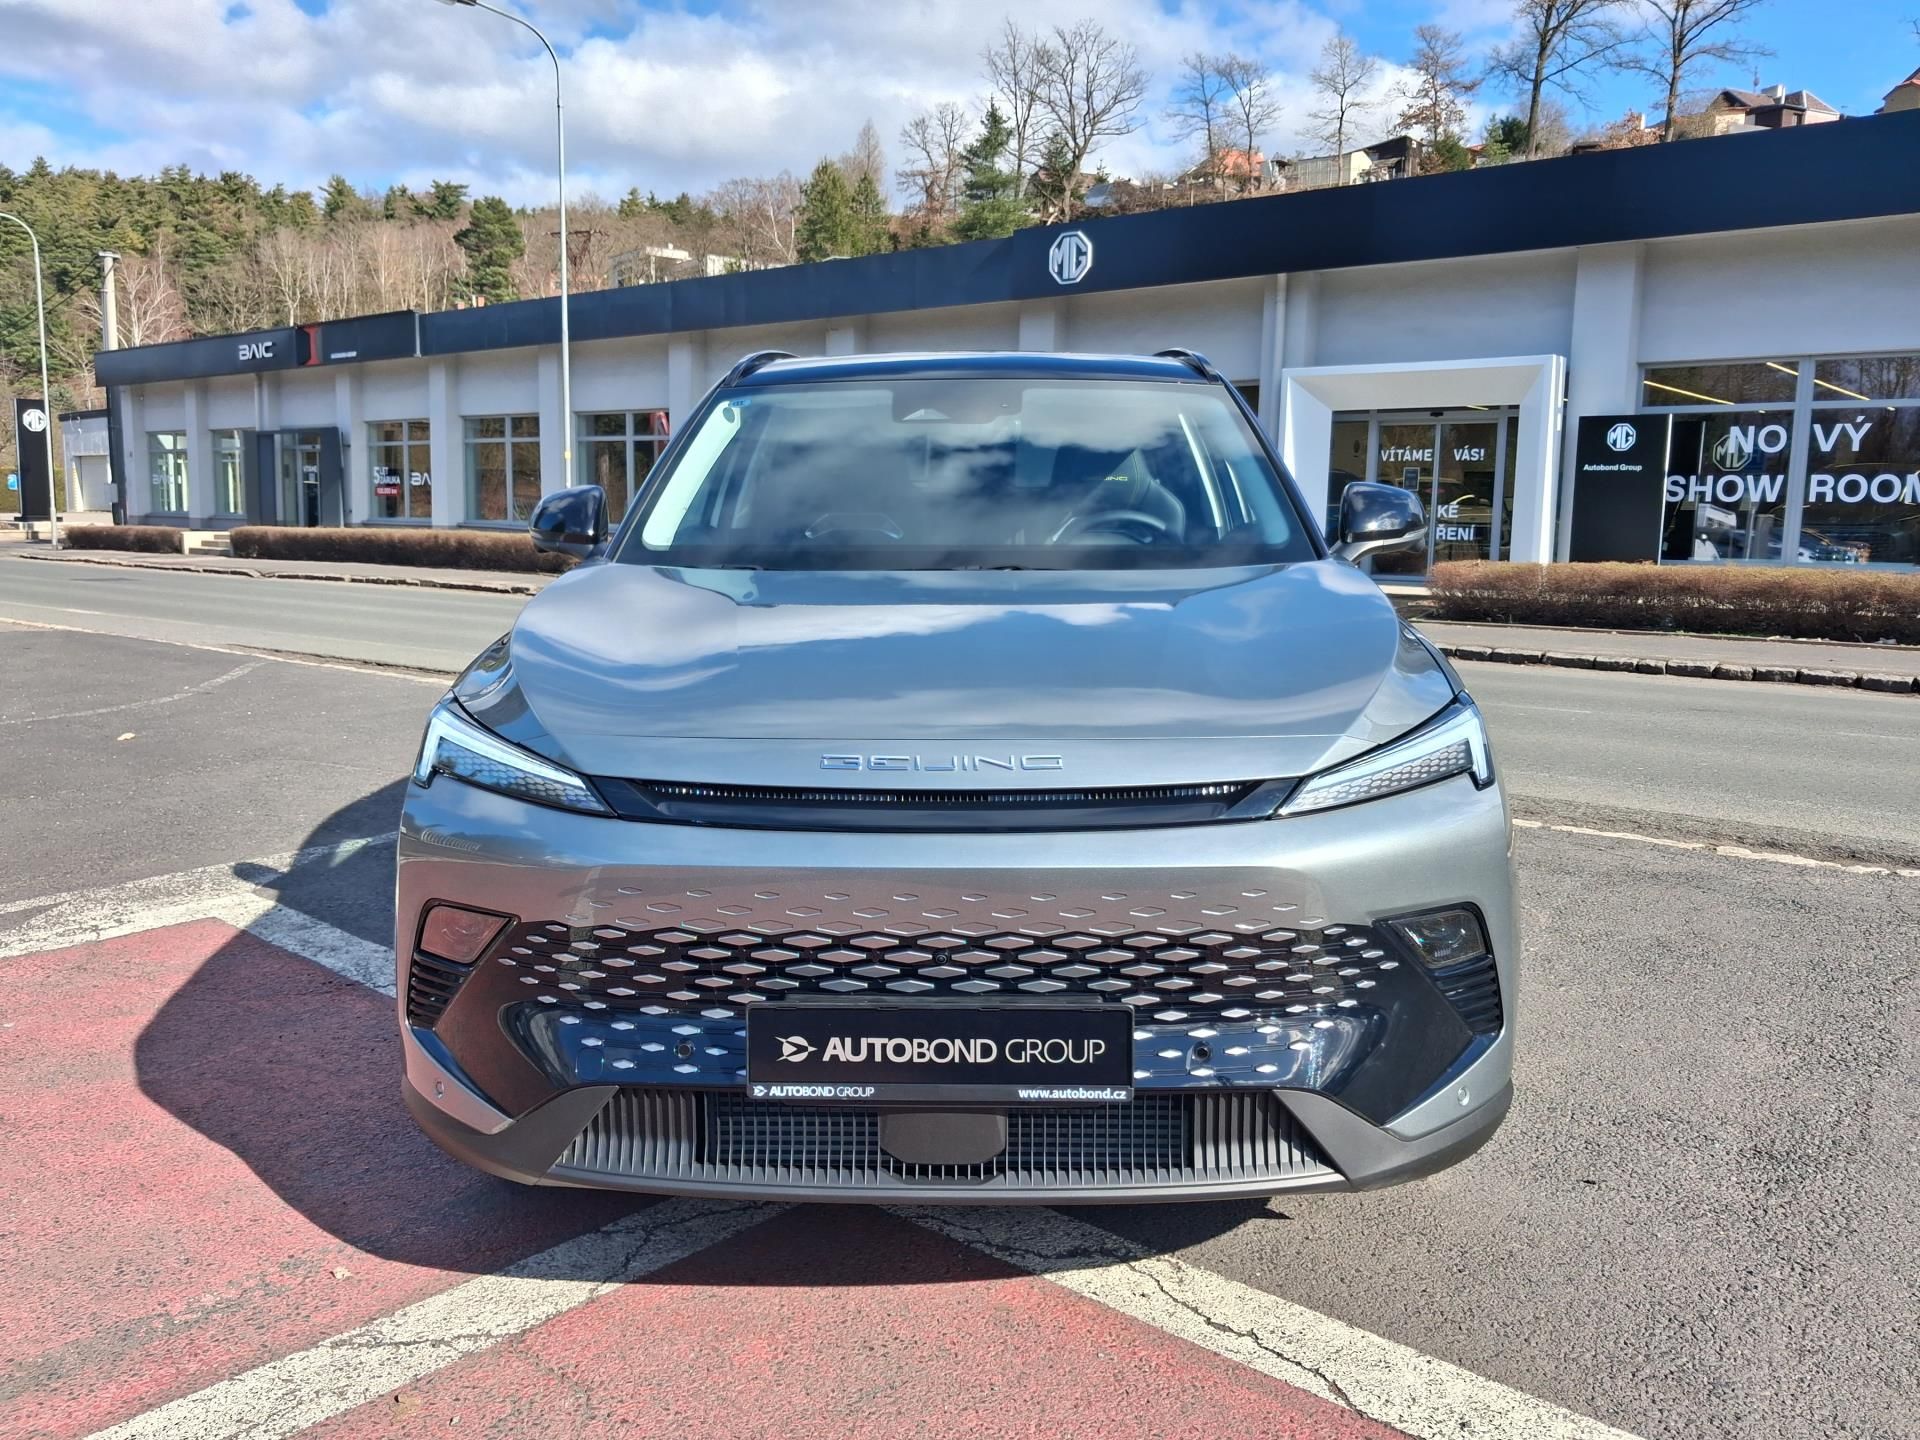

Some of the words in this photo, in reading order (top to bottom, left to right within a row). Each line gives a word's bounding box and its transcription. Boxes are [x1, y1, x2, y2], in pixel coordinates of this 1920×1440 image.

[1051, 233, 1090, 282] MG
[238, 341, 273, 360] BAIC
[24, 410, 46, 431] MG
[1608, 424, 1635, 450] MG
[1380, 445, 1433, 462] VÍTÁME
[1453, 445, 1485, 461] VÁS!
[1619, 464, 1642, 472] Group
[410, 471, 432, 486] BA
[1665, 474, 1785, 503] SHOW
[820, 754, 1064, 771] BEIJING
[822, 1036, 998, 1064] AUTOBOND
[1004, 1037, 1106, 1065] GROUP
[768, 1085, 835, 1097] AUTOBOND
[836, 1086, 876, 1098] GROUP
[1018, 1087, 1127, 1099] www.autobond.cz
